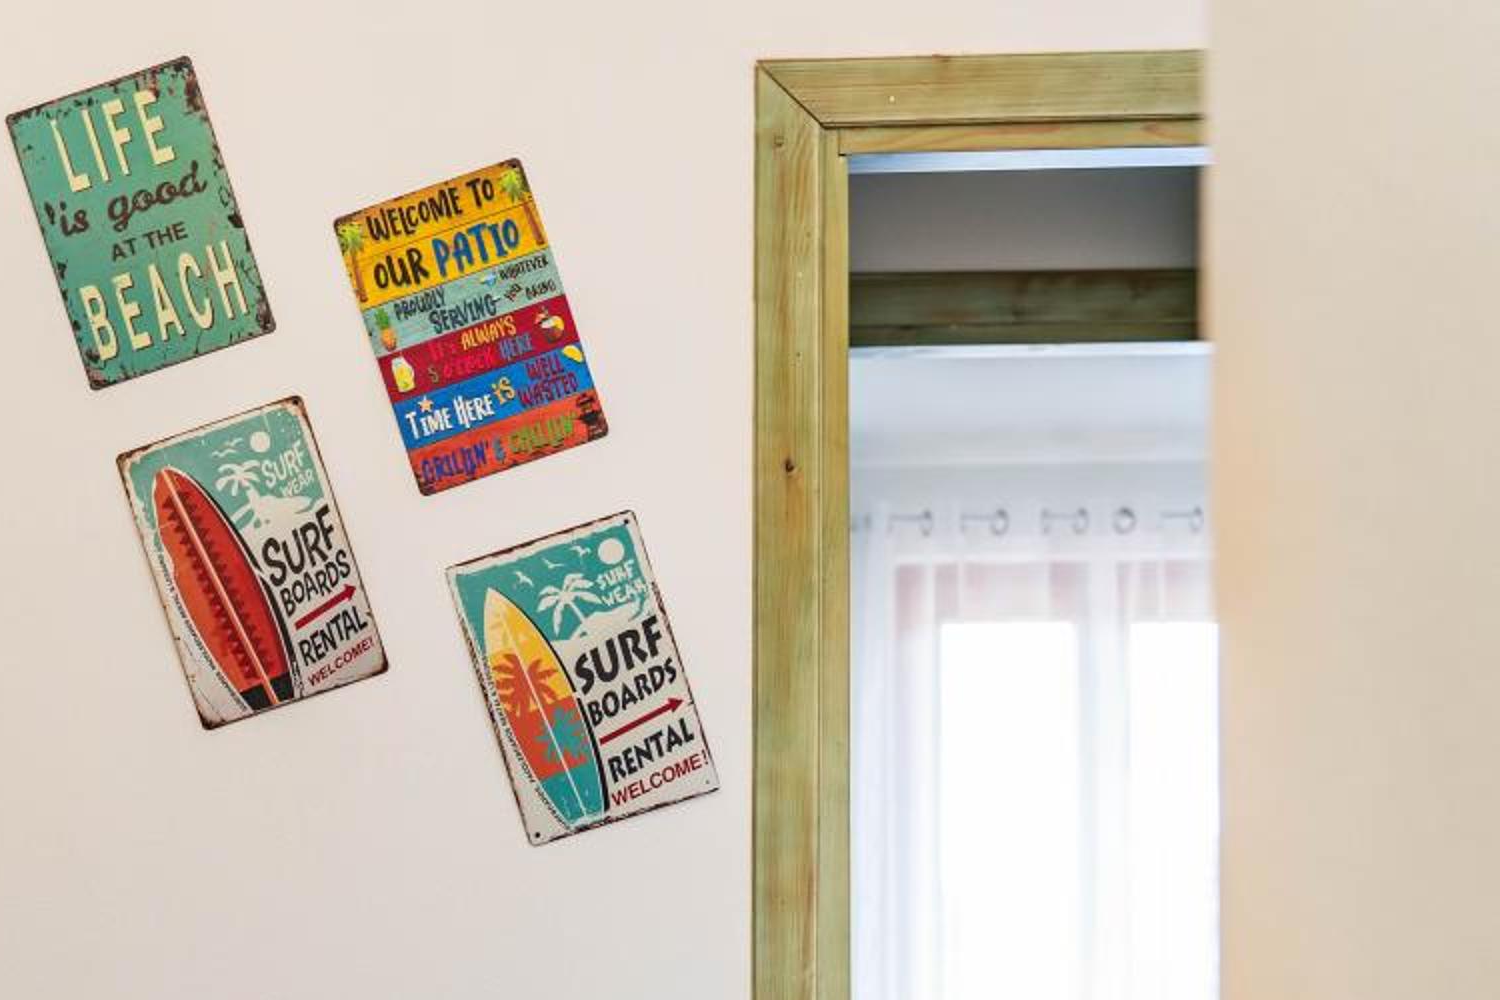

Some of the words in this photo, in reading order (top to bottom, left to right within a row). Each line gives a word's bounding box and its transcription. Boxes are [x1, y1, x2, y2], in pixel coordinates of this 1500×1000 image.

[49, 90, 175, 192] LIFE
[107, 160, 208, 232] good
[366, 187, 463, 241] WELCOME
[466, 178, 494, 208] TO
[111, 238, 137, 262] AT
[142, 222, 188, 250] THE
[373, 247, 430, 289] OUR
[432, 218, 519, 277] PATIO
[79, 240, 249, 361] BEACH
[394, 286, 445, 320] PROUDLY
[428, 294, 497, 334] SERVING
[461, 315, 516, 350] ALWAYS
[452, 395, 495, 429] HERE
[261, 440, 305, 489] SURF
[263, 505, 334, 587] SURF
[280, 552, 351, 617] BOARDS
[299, 606, 367, 666] RENTAL
[307, 638, 375, 687] WELCOME!
[575, 615, 662, 694] SURF
[587, 658, 677, 728] BOARDS
[607, 717, 695, 783] RENTAL
[611, 749, 709, 807] WELCOME!
